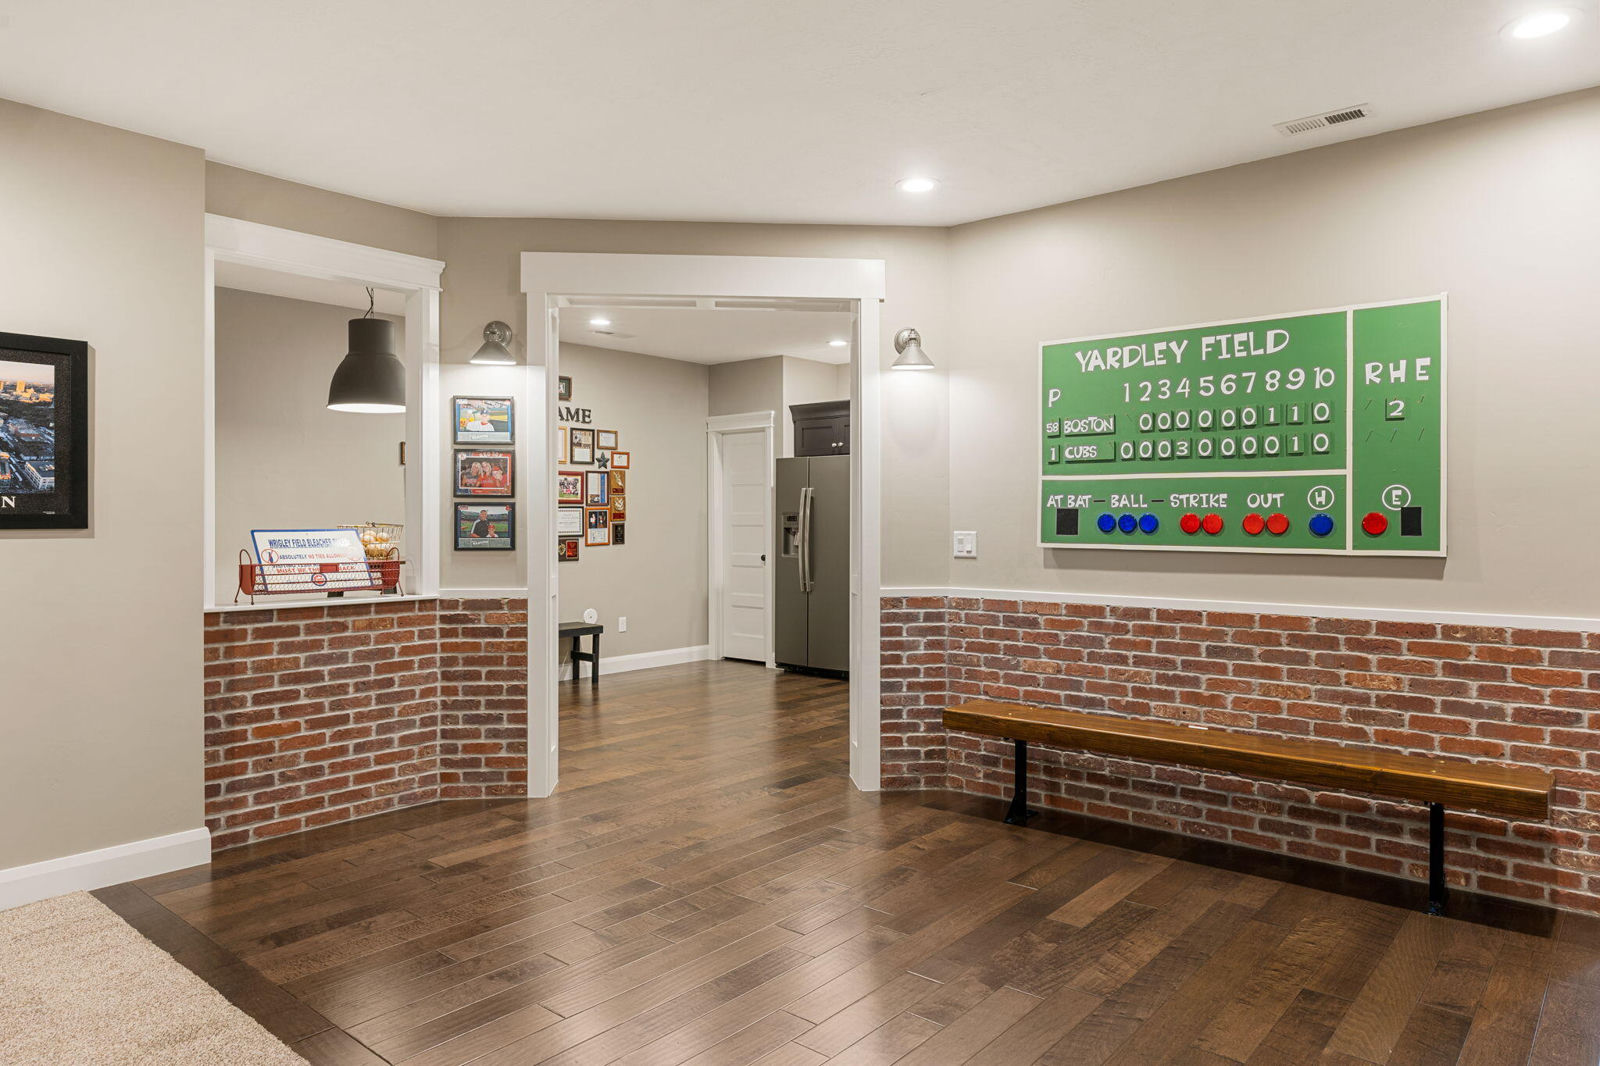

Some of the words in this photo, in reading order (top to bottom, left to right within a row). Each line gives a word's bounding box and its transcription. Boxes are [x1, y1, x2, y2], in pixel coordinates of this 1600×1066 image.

[1074, 339, 1189, 373] YARDLEY
[1201, 329, 1290, 361] FIELD
[1047, 388, 1062, 408] P
[1123, 382, 1130, 403] 1
[1138, 381, 1152, 402] 2
[1157, 378, 1171, 400] 3
[1175, 377, 1191, 398] 4
[1199, 375, 1215, 397] 5
[1220, 373, 1237, 395] 6
[1241, 371, 1257, 394] 7
[1264, 369, 1281, 392] 8
[1285, 367, 1306, 390] 9
[1313, 366, 1335, 389] 10
[1388, 399, 1405, 417] 2
[1045, 422, 1060, 433] 58
[1063, 416, 1114, 434] BOSTON
[1064, 445, 1098, 459] CUBS
[1, 495, 16, 508] N
[1046, 494, 1064, 508] AT
[1067, 494, 1092, 508] BAT
[1110, 494, 1148, 508] BALL
[1169, 493, 1228, 508] STRIKE
[1246, 493, 1285, 508] OUT
[1315, 489, 1326, 505] H
[1391, 489, 1402, 505] E
